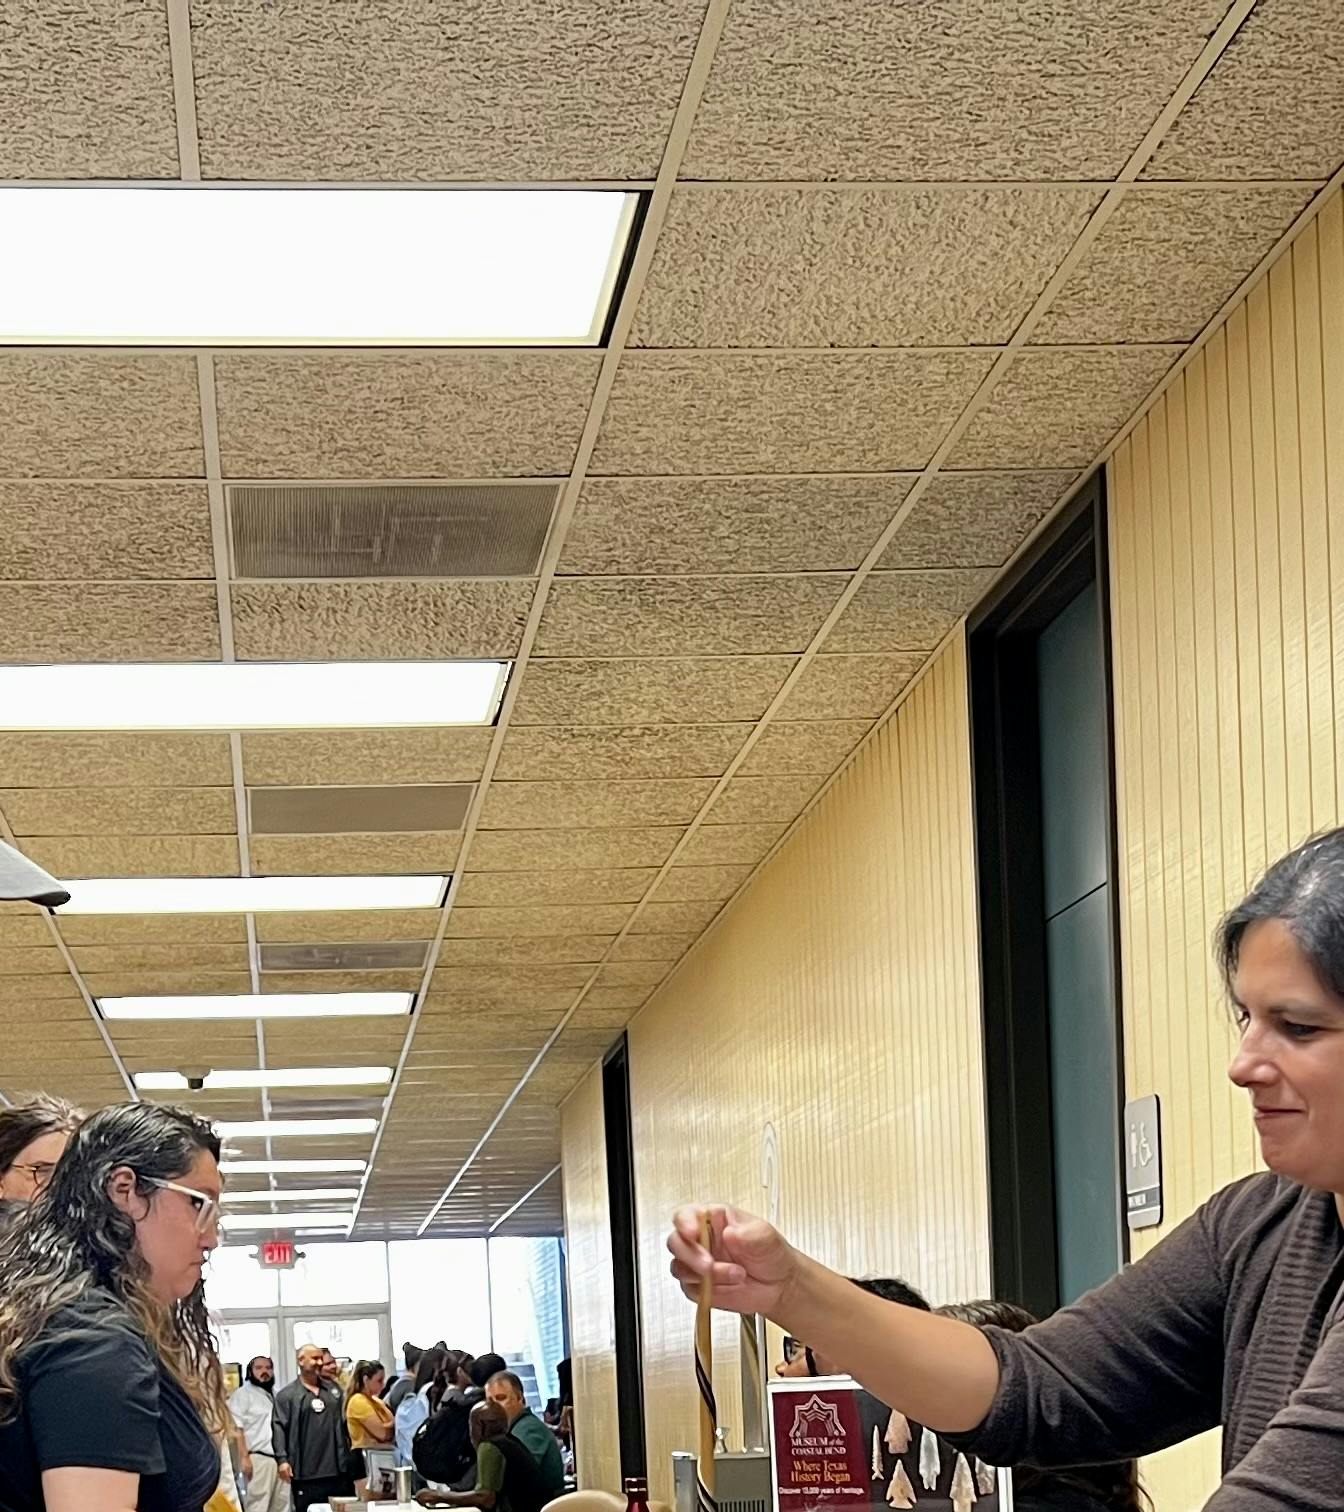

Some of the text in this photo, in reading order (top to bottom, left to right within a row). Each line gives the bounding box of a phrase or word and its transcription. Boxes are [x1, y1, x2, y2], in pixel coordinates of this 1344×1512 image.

[263, 1243, 292, 1264] EXIT
[791, 1437, 828, 1447] MUSEUM
[791, 1446, 846, 1456] COASTAL BEND
[793, 1460, 847, 1472] Where Texas
[791, 1471, 851, 1484] History Began
